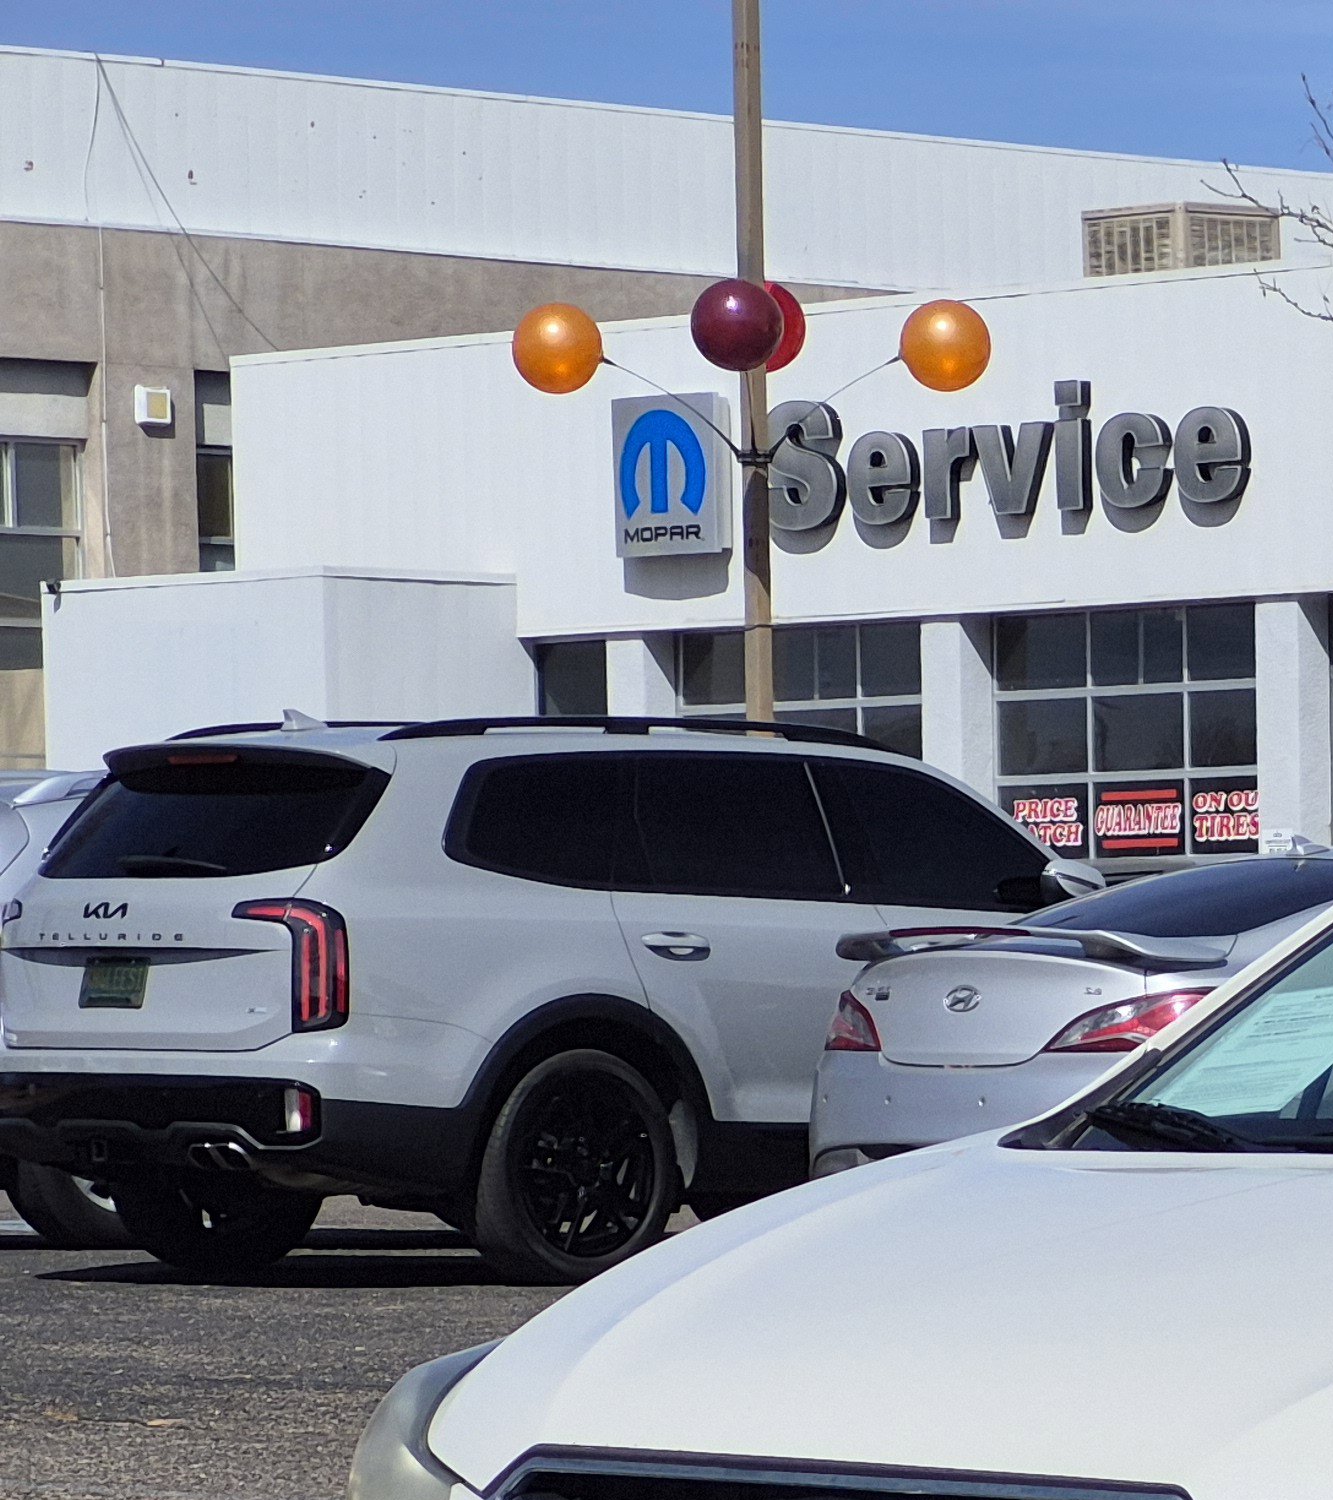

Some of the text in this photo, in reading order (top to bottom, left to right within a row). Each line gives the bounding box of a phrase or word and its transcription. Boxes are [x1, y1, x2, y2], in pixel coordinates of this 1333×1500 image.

[767, 379, 1252, 531] Service
[624, 524, 701, 544] MOPAR
[1013, 797, 1078, 822] PRICE
[1192, 789, 1260, 812] ON OU
[1095, 803, 1181, 836] GUARANTEE
[1193, 812, 1260, 842] TIRES
[83, 902, 128, 919] KIA
[39, 932, 183, 942] TELLURIDE
